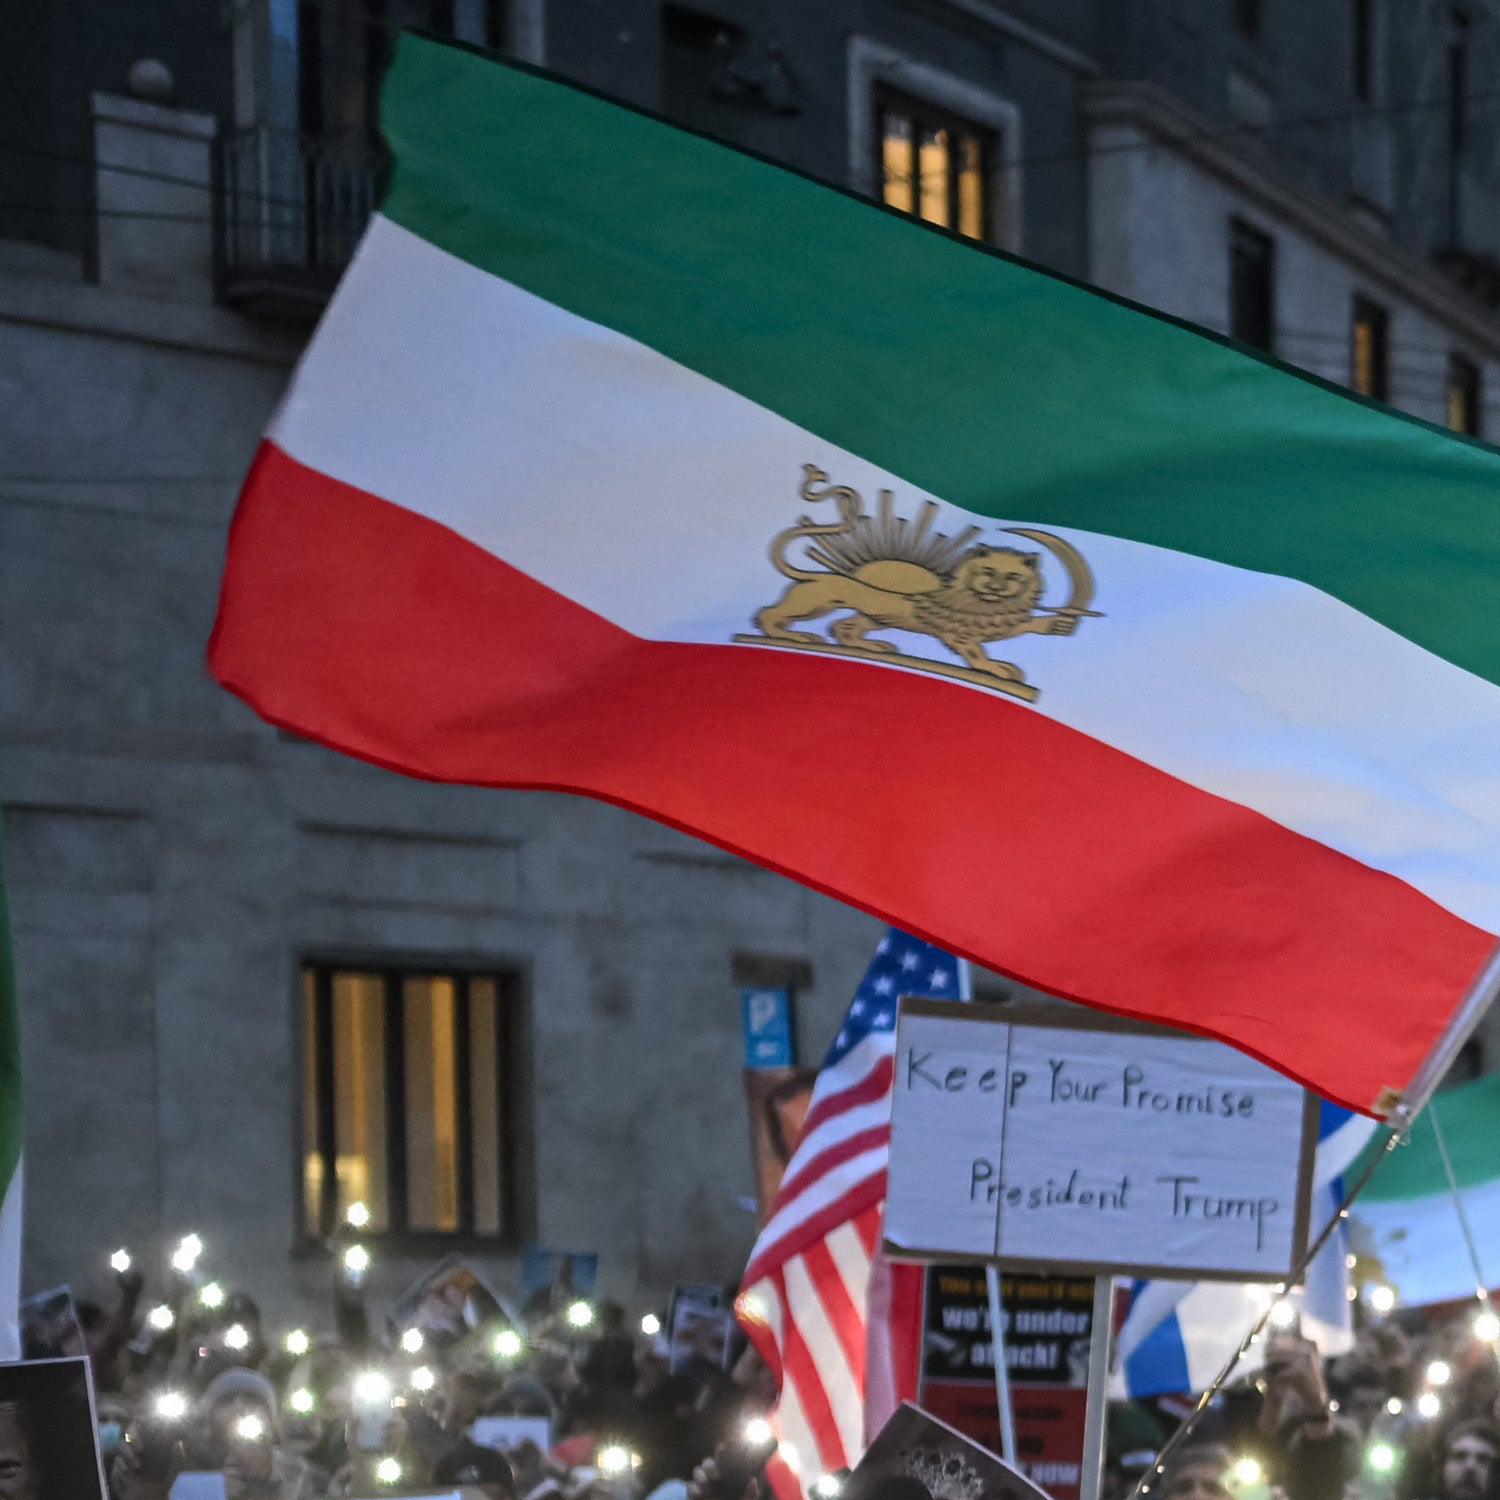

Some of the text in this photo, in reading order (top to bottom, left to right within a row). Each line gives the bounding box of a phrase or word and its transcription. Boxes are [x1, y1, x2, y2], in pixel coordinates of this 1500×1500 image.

[906, 1047, 1255, 1119] Keep Your Promise
[970, 1157, 1280, 1251] President Trump
